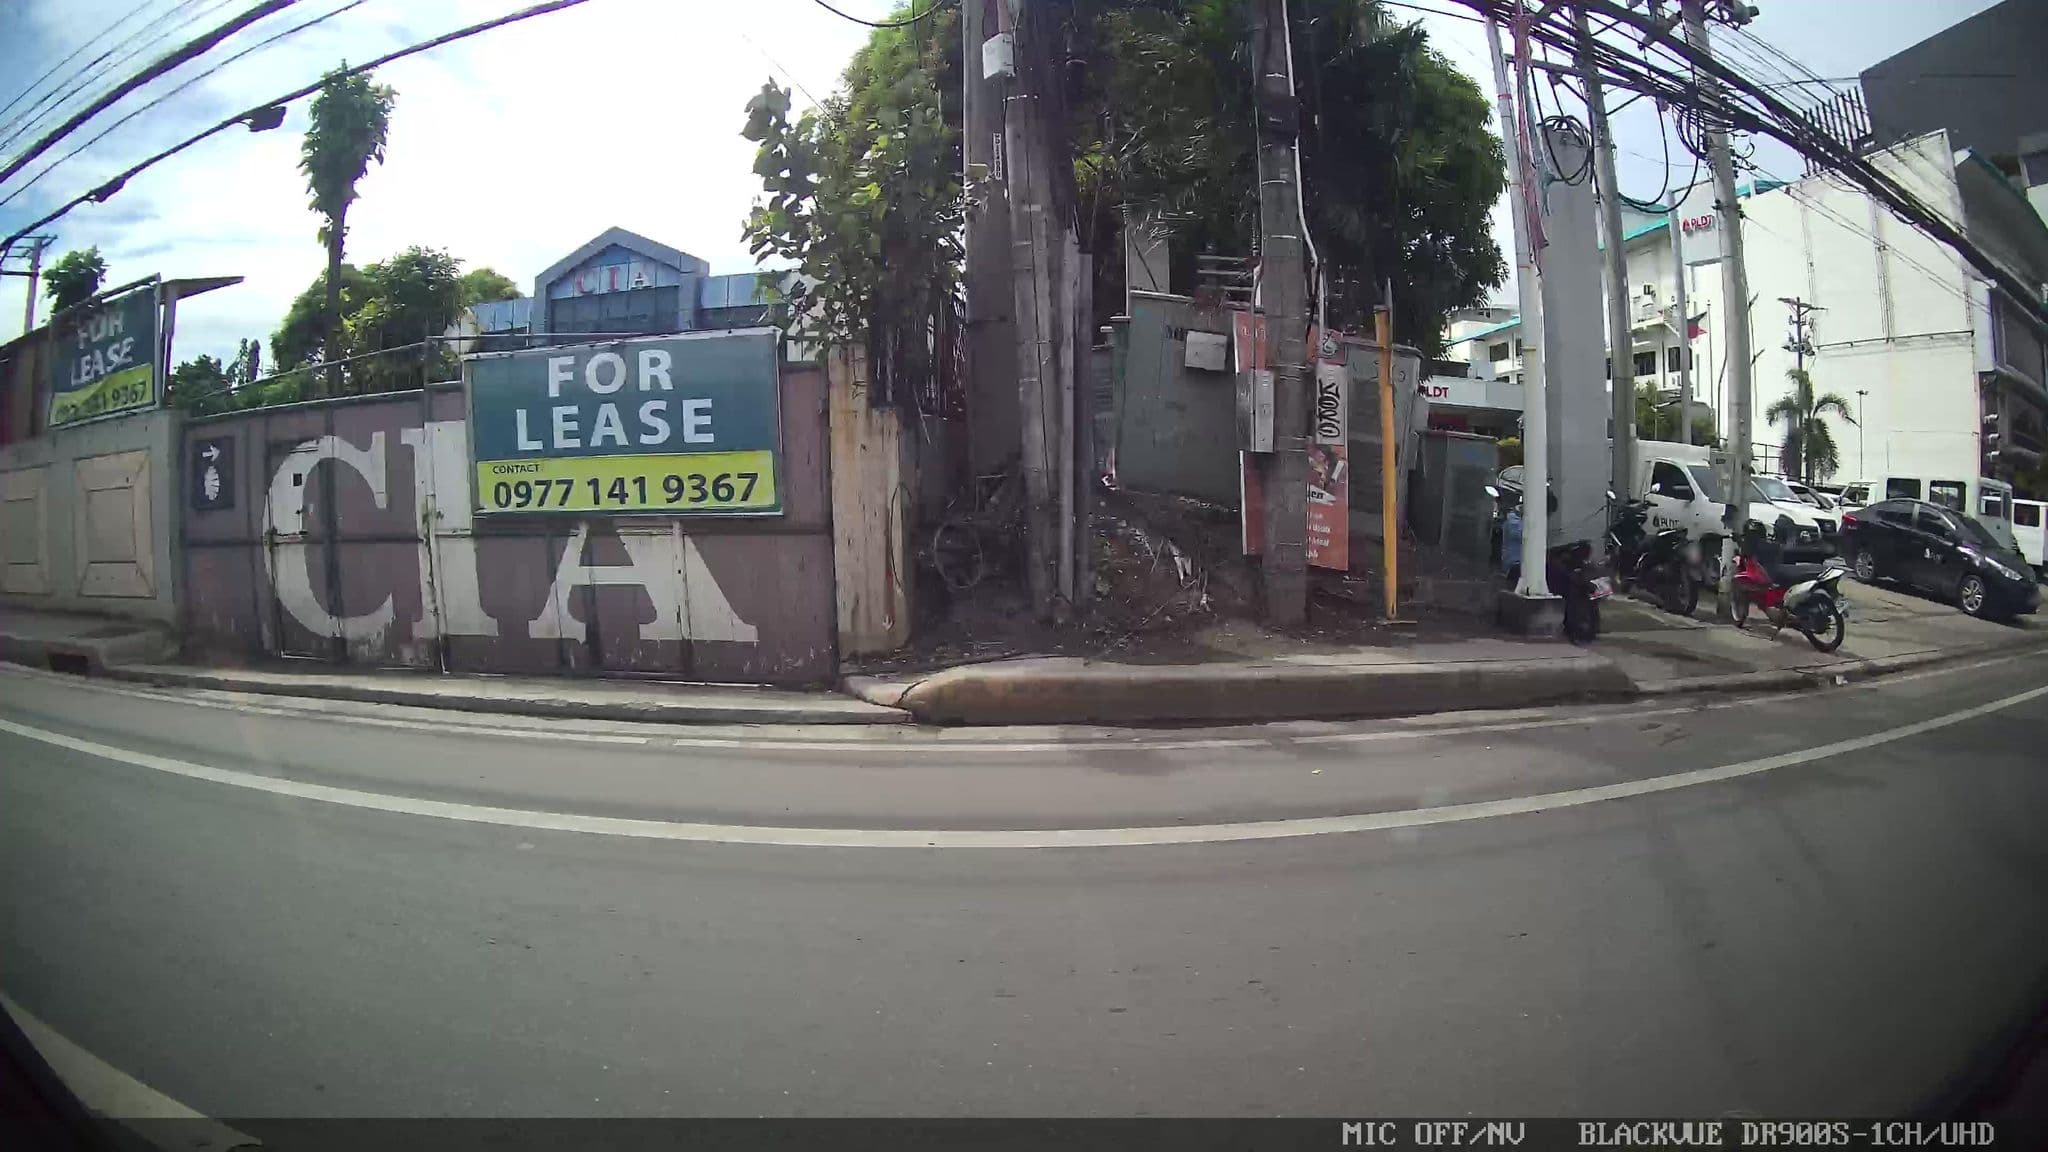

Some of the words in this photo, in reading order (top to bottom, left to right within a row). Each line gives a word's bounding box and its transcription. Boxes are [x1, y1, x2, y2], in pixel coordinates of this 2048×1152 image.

[1690, 214, 1712, 227] PLDT
[71, 336, 135, 386] LEASE
[547, 349, 674, 397] FOR
[515, 398, 715, 451] LEASE
[494, 479, 575, 509] 0977
[586, 476, 648, 505] 141
[662, 472, 759, 503] 9367
